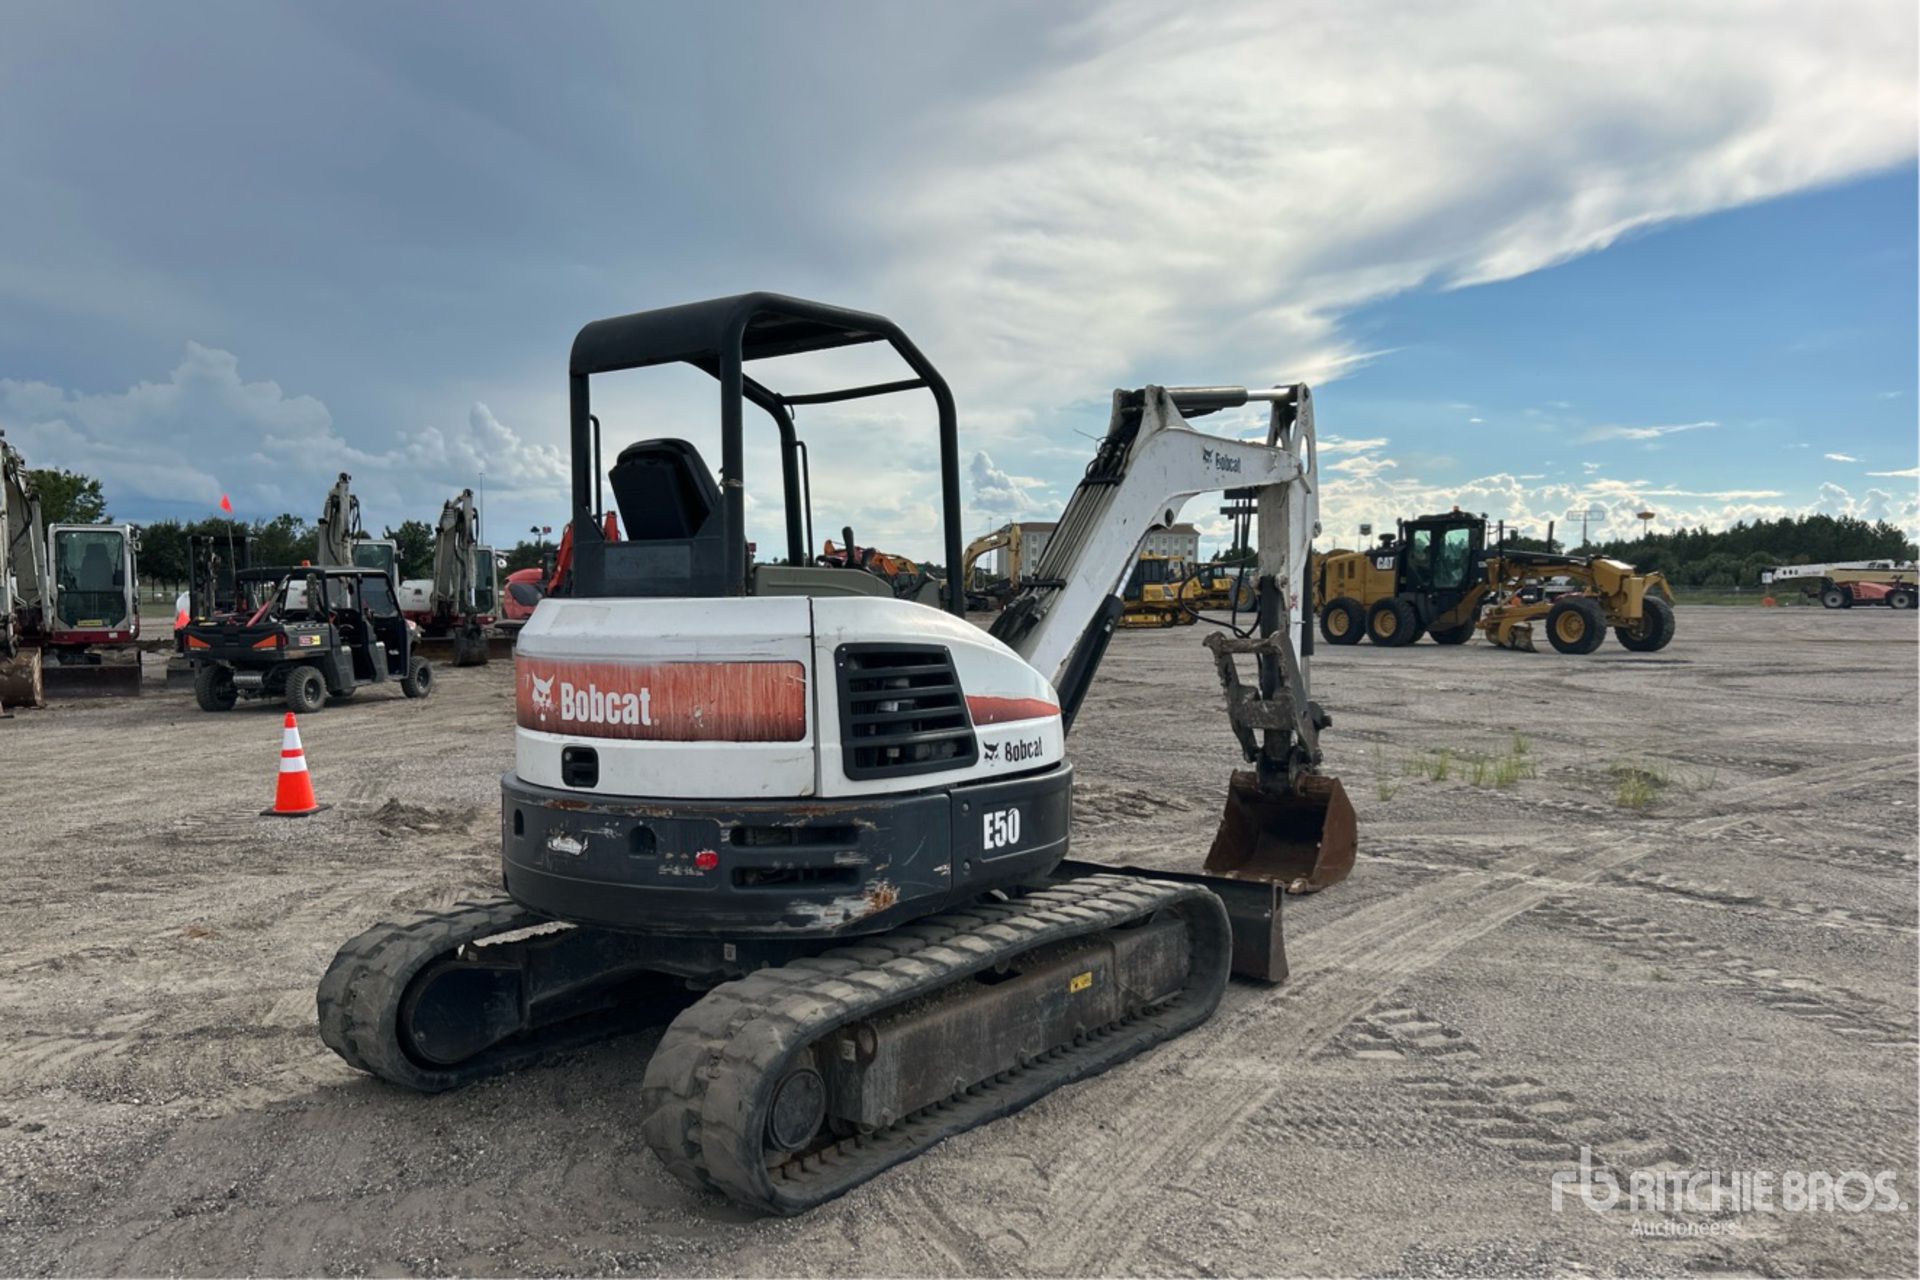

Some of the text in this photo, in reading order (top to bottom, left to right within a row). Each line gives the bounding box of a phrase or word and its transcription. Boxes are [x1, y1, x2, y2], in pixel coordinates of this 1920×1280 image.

[1376, 556, 1394, 570] CAT
[560, 682, 651, 726] Bobcat
[1004, 736, 1043, 762] Bobcat
[983, 807, 1020, 850] E50
